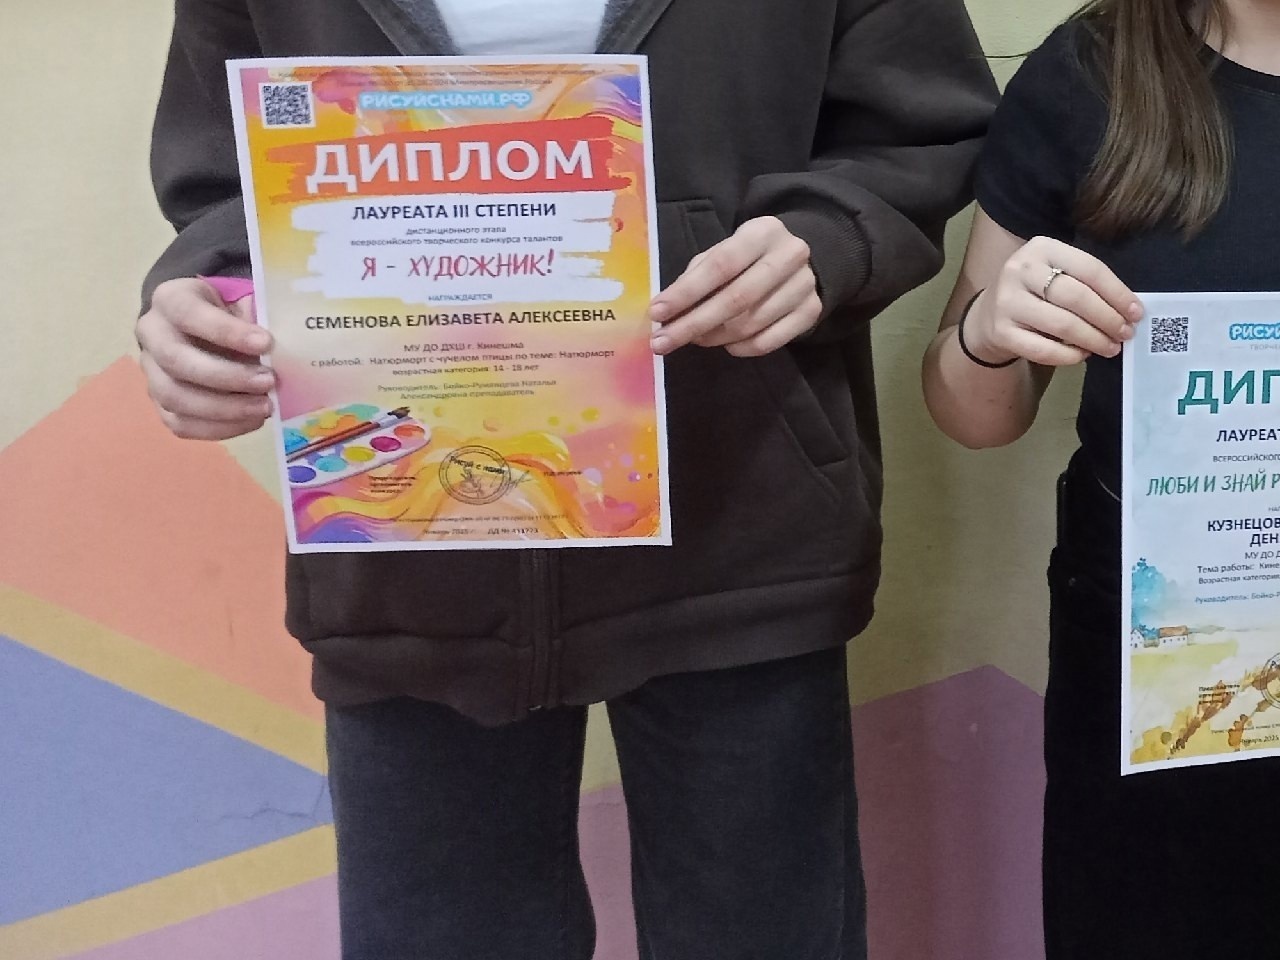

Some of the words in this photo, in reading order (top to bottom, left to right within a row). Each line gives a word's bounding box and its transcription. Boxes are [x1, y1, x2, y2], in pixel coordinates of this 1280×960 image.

[359, 90, 533, 109] РИСУЙСНАМИ.РФ
[305, 139, 594, 194] ДИПЛОМ
[352, 205, 448, 220] ЛАУРЕАТА
[453, 205, 469, 218] III
[475, 203, 556, 217] СТЕПЕНИ
[351, 237, 422, 246] всероссийского
[424, 237, 478, 245] творческого
[480, 236, 521, 244] конкурса
[361, 257, 377, 280] Я
[408, 248, 555, 281] ХУДОЖНИК!
[305, 315, 402, 329] СЕМЕНОВА
[406, 311, 504, 327] ЕЛИЗАВЕТА
[508, 309, 616, 324] АЛЕКСЕЕВНА
[403, 344, 420, 352] МУ
[422, 344, 439, 352] ДО
[440, 343, 465, 352] ДХШ
[477, 342, 524, 350] Кинешма
[370, 357, 427, 366] Натюрморт
[436, 355, 479, 363] чучелом
[482, 354, 512, 362] птицы
[559, 350, 615, 359] Натюрморт
[1146, 475, 1199, 496] ЛЮБИ
[1203, 475, 1216, 492] И
[1221, 467, 1267, 492] ЗНАЙ
[1260, 551, 1274, 559] ДО
[1197, 565, 1219, 573] Тема
[1198, 576, 1241, 584] Возрастная
